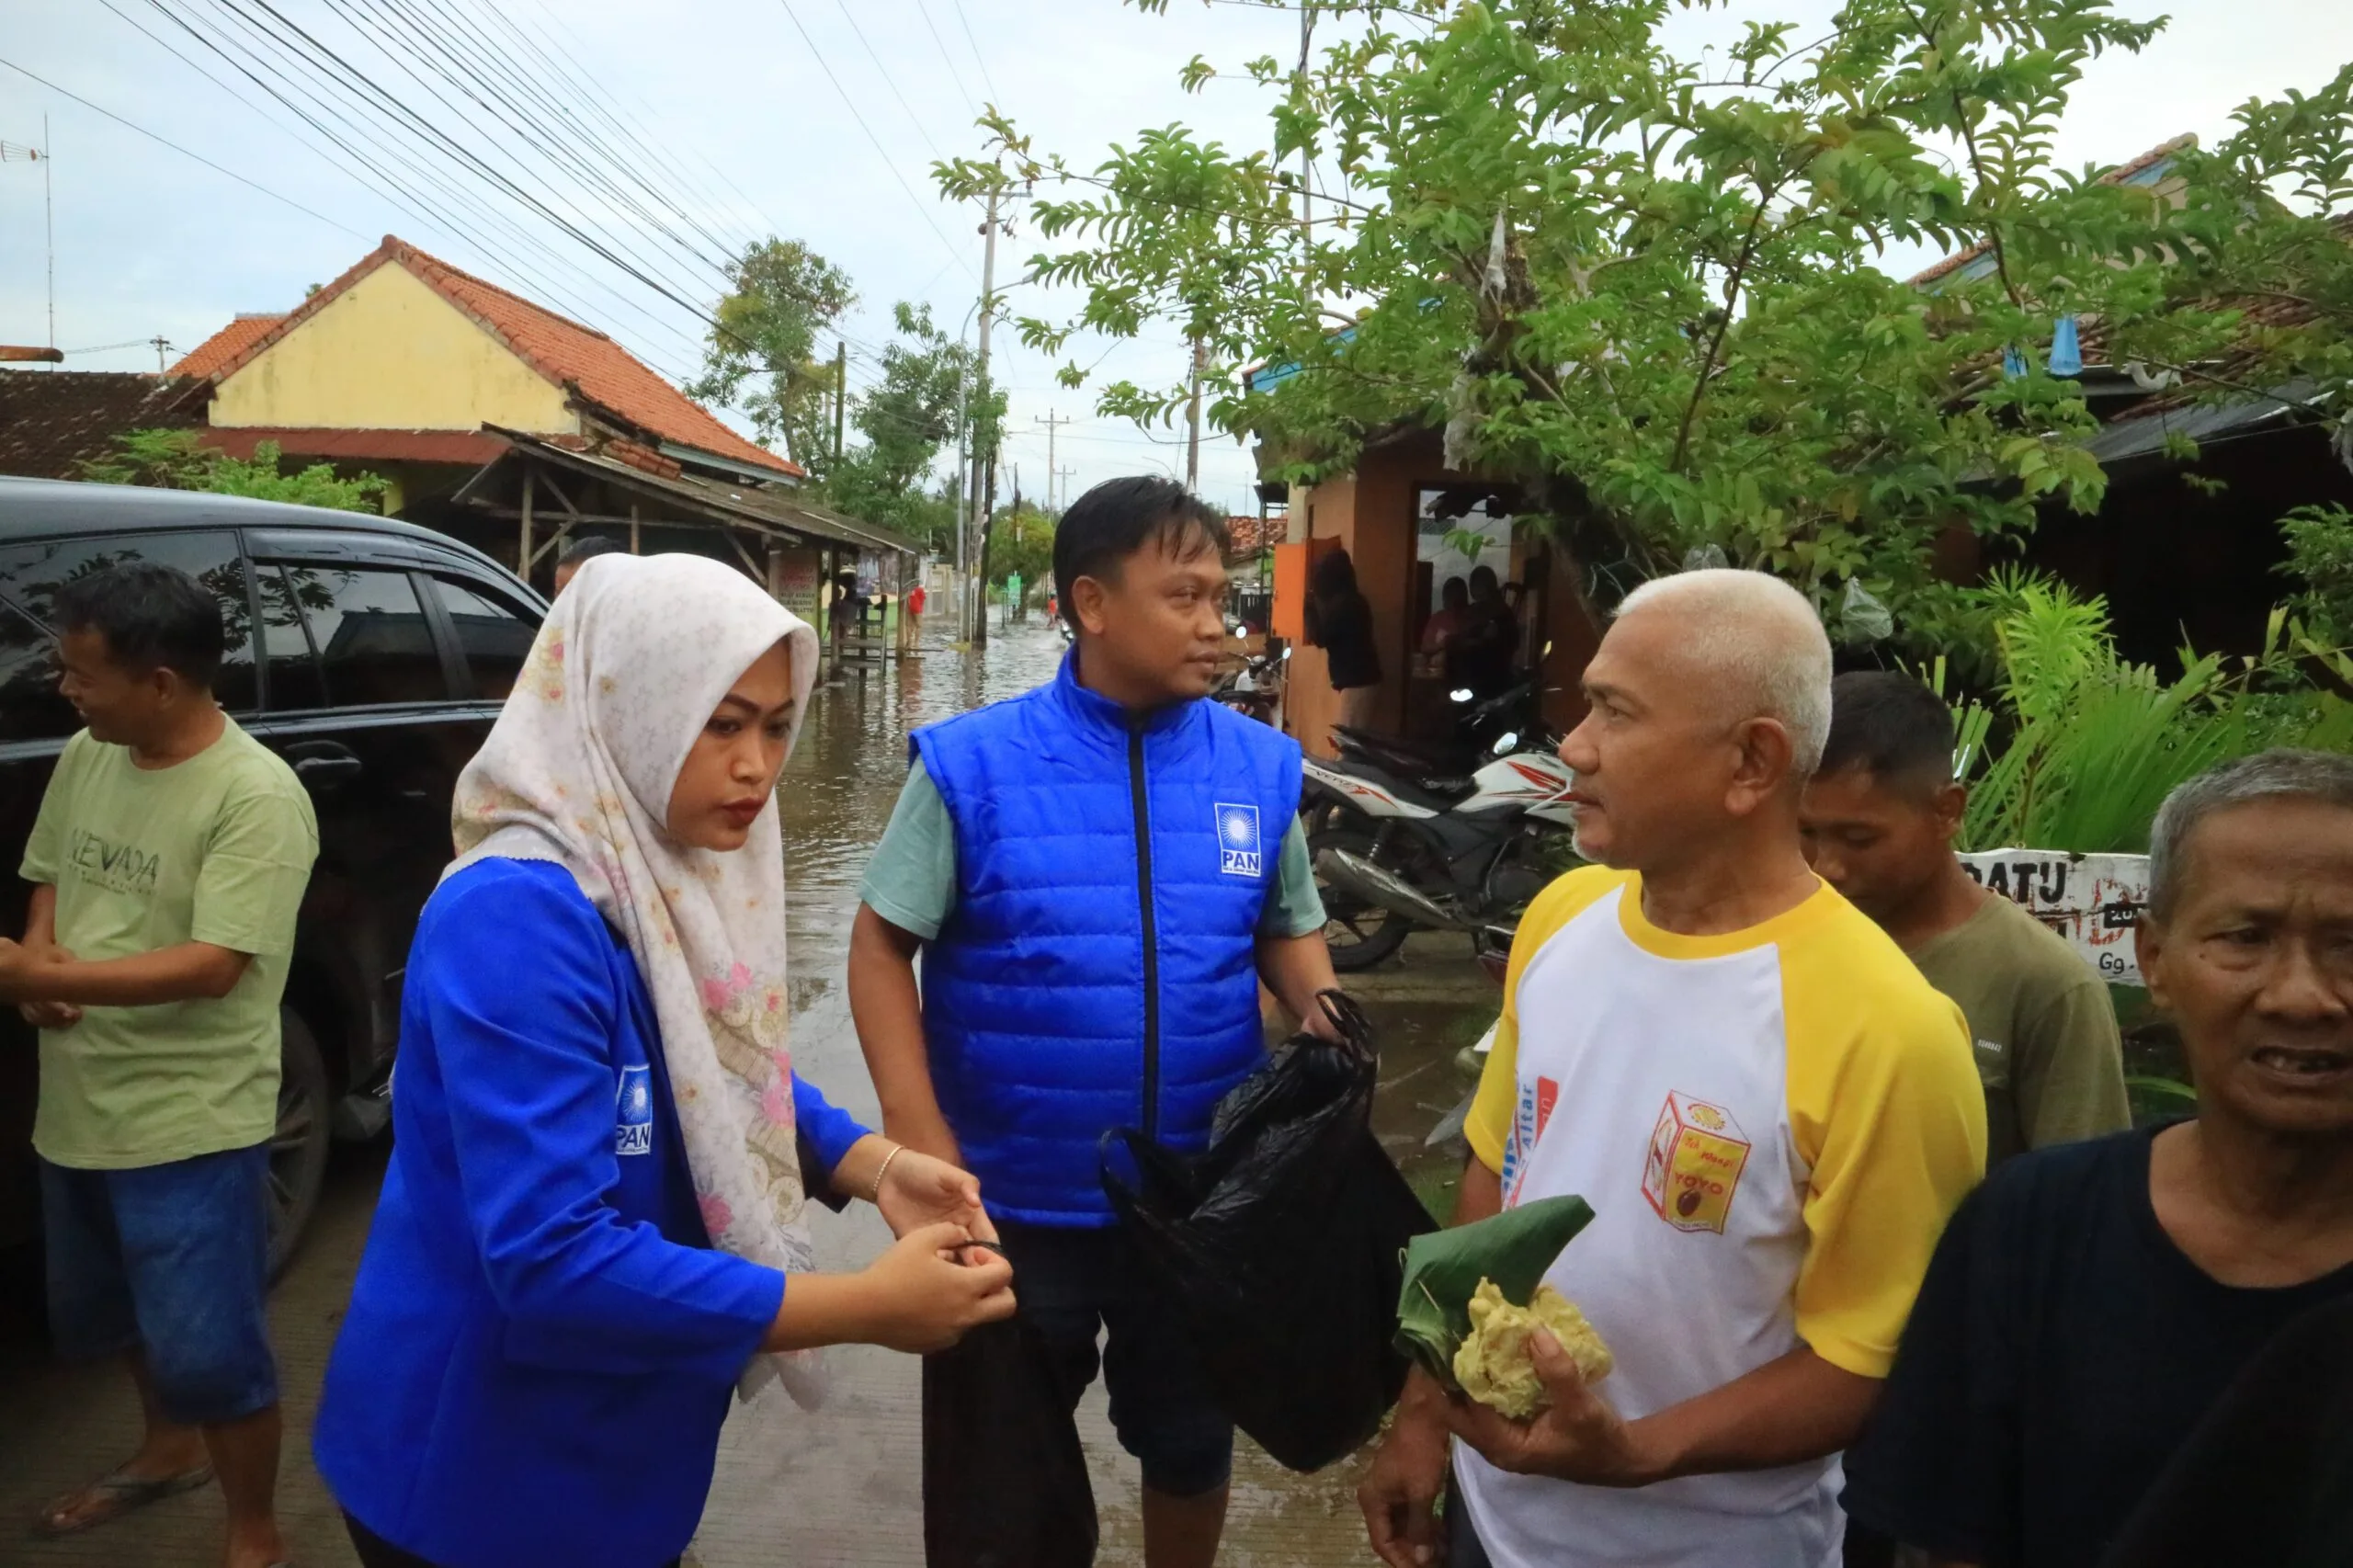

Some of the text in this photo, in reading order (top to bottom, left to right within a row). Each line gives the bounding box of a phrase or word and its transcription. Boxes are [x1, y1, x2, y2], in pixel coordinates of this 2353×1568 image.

[1222, 851, 1259, 870] PAN
[617, 1126, 650, 1148] PAN
[1675, 1172, 1723, 1195] YOYO
